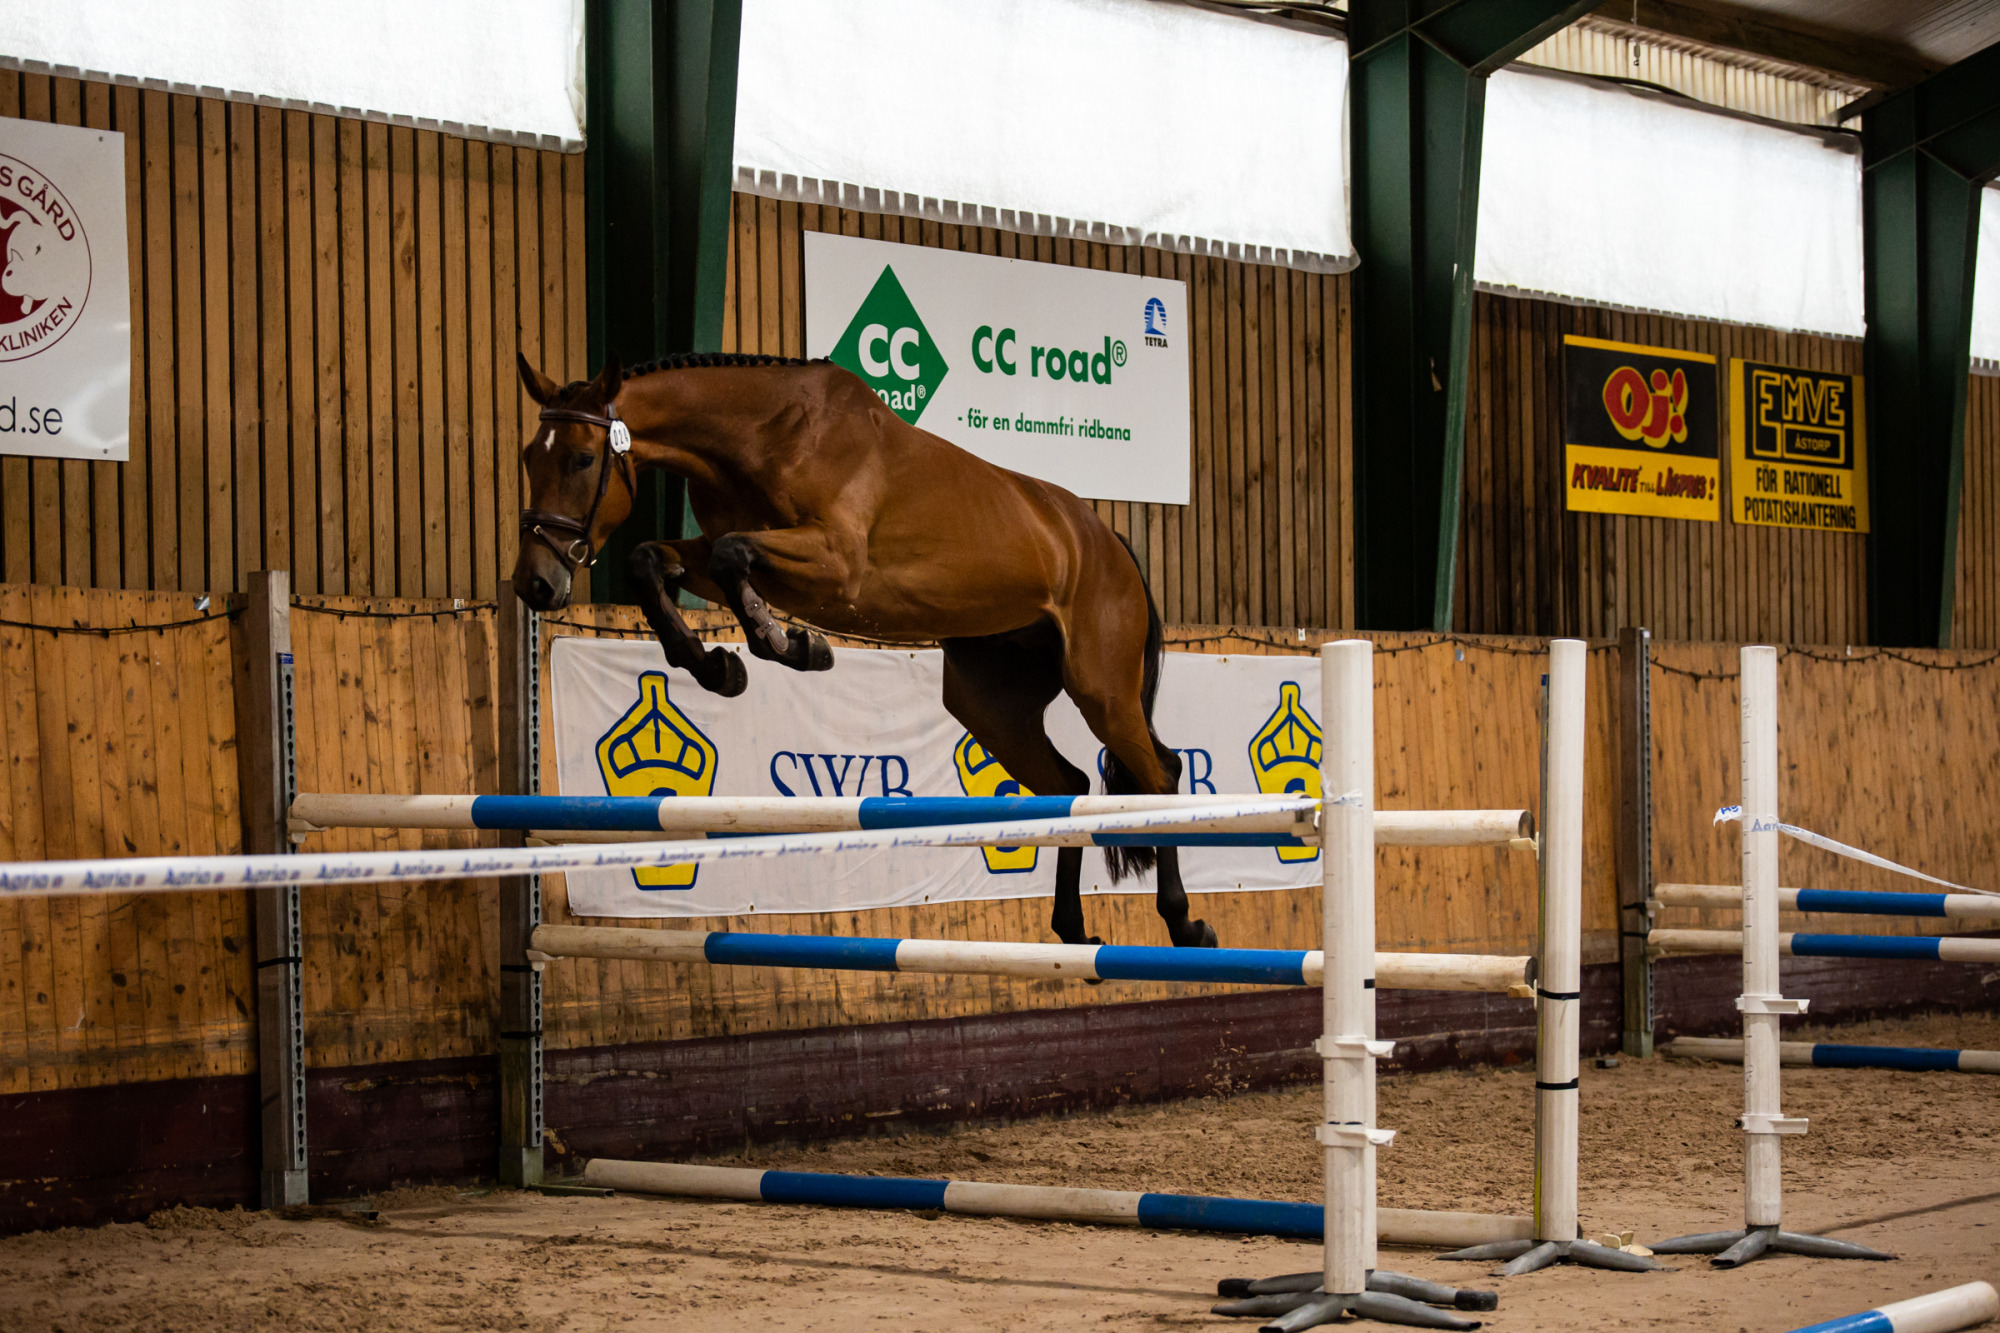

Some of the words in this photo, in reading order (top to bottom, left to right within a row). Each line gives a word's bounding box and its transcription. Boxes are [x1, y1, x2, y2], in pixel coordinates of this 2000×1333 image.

[858, 323, 920, 381] CC
[971, 325, 1017, 376] CC
[1145, 336, 1168, 348] TETRA
[967, 407, 989, 429] för
[993, 416, 1010, 431] en
[1015, 412, 1074, 436] dammfri
[1078, 419, 1131, 441] ridbana
[1794, 432, 1831, 451] ÅSTORP
[1756, 464, 1778, 493] FÖR
[1784, 470, 1842, 499] RATIONELL
[1744, 496, 1857, 530] POTATISHANTERING
